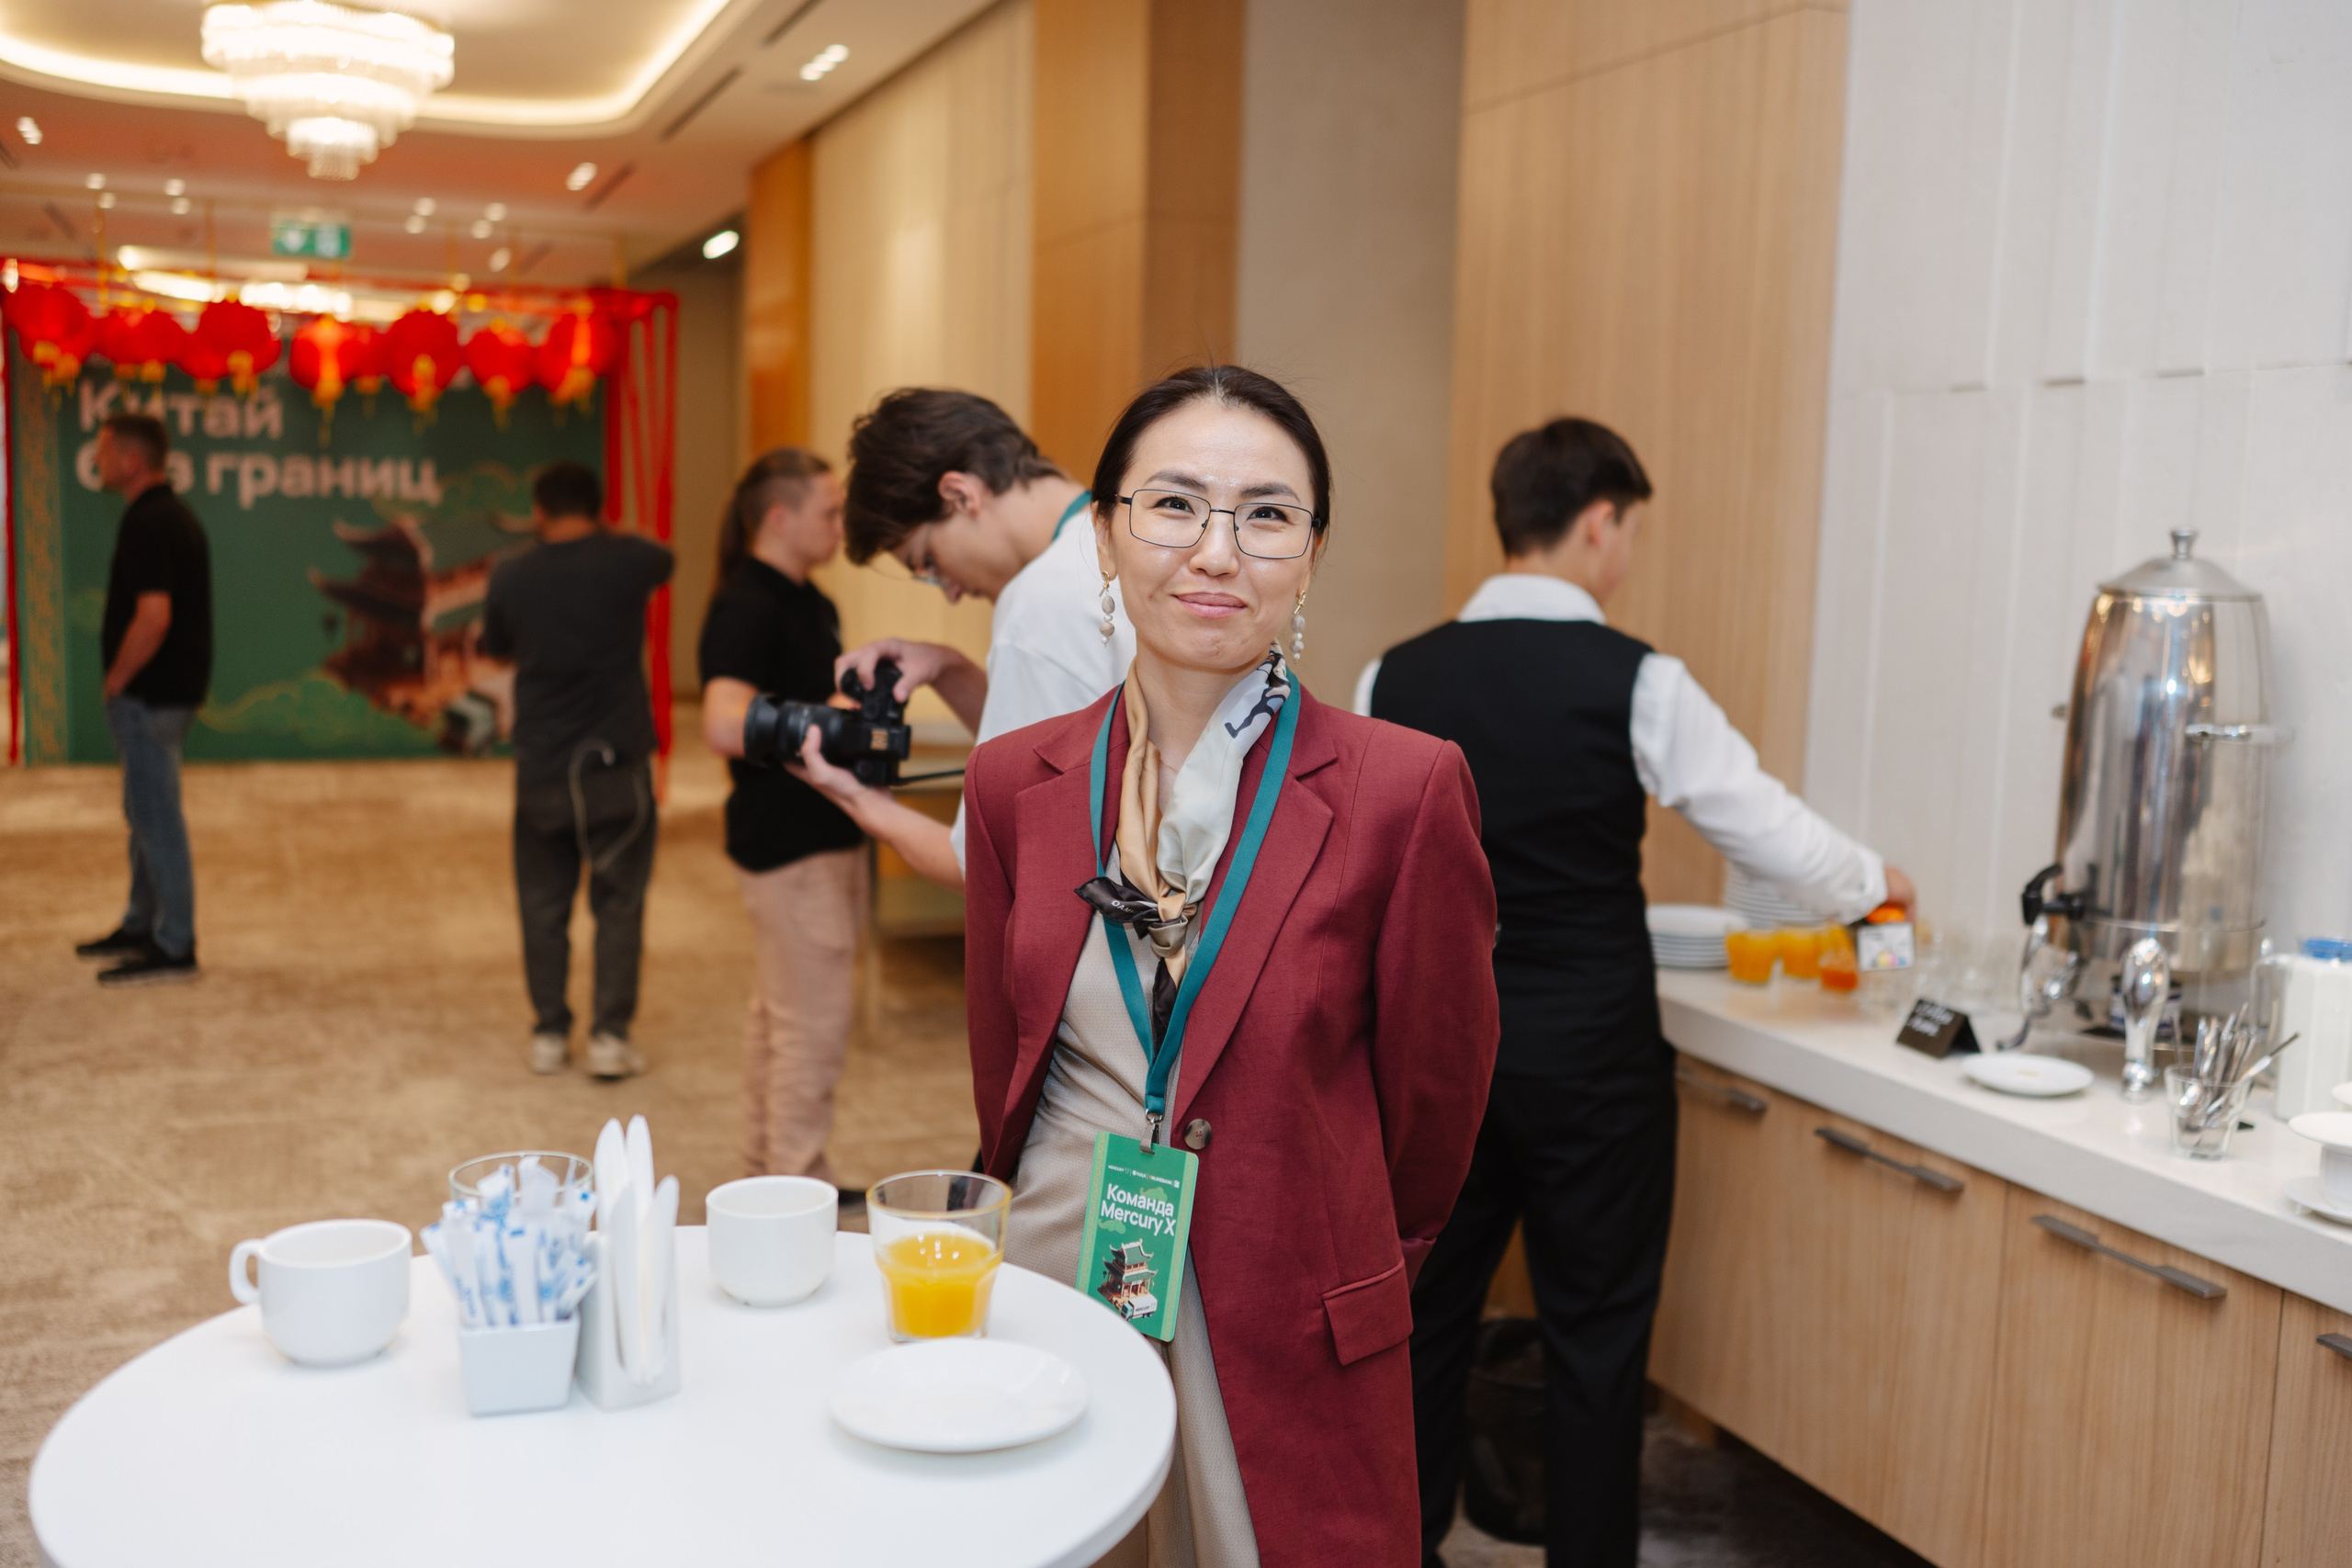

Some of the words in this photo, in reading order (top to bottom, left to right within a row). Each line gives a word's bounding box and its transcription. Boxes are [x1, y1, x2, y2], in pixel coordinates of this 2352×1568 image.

[79, 378, 284, 440] Китай
[206, 452, 444, 511] границ
[1101, 1200, 1163, 1236] Mercury
[1163, 1217, 1176, 1236] X
[1106, 1183, 1174, 1217] Команда
